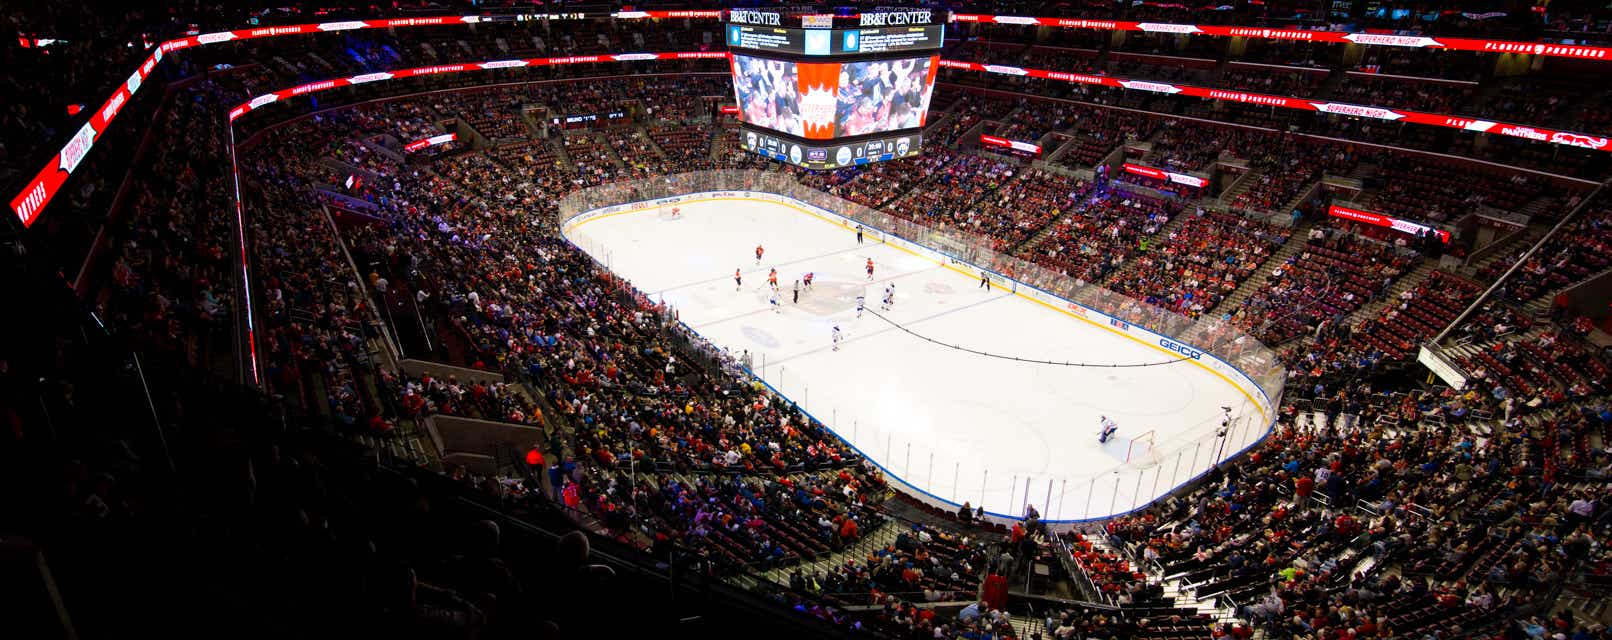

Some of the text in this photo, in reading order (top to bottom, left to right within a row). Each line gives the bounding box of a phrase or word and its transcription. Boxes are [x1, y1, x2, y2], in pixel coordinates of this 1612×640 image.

[730, 11, 780, 25] BB&T CENTER
[860, 11, 932, 26] BB&T CENTER
[1230, 29, 1312, 39] FLORIDA PANTHERS
[1356, 35, 1421, 45] SUPERHERO NIGHT
[1485, 42, 1605, 58] FLORIDA PANTHERS
[1209, 91, 1287, 105] FLORIDA PANTHERS
[1327, 104, 1388, 119] SUPERHERO NIGHT
[1501, 127, 1548, 141] PANTHERS
[856, 147, 863, 157] 0
[887, 142, 893, 152] 0
[1159, 338, 1201, 360] GEICO
